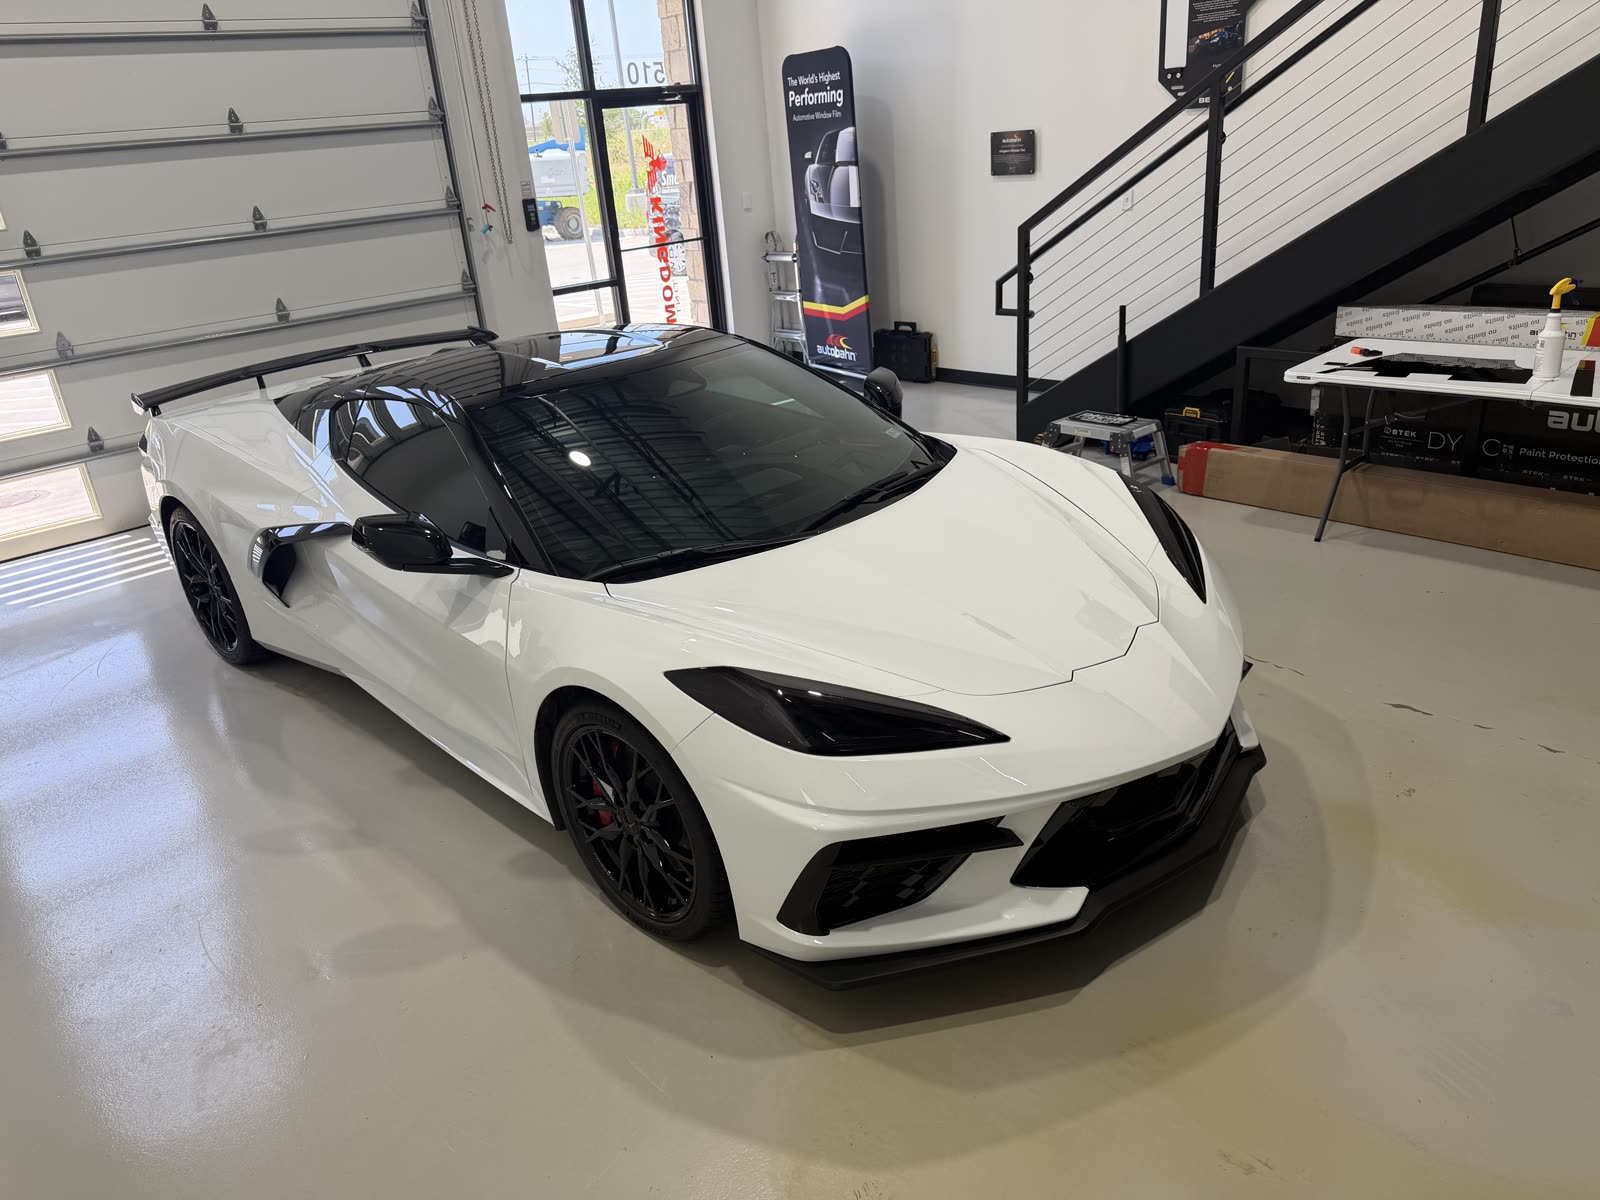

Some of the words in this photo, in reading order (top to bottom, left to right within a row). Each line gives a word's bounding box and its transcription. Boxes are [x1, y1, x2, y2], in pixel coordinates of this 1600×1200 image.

[787, 76, 798, 87] The
[797, 73, 818, 86] World's
[818, 70, 841, 85] Highest
[788, 85, 844, 108] Performing
[792, 113, 815, 122] Automotive
[814, 110, 832, 119] Window
[831, 109, 842, 118] Film
[1382, 310, 1400, 318] limits
[1402, 313, 1421, 322] limits
[1346, 318, 1364, 327] limits
[1423, 320, 1442, 329] limits
[1485, 316, 1505, 324] limits
[1365, 323, 1383, 331] limits
[1444, 325, 1464, 334] limits
[1508, 321, 1529, 331] limits
[1467, 331, 1487, 340] limits
[816, 345, 857, 362] autobahn
[1519, 447, 1546, 459] Paint
